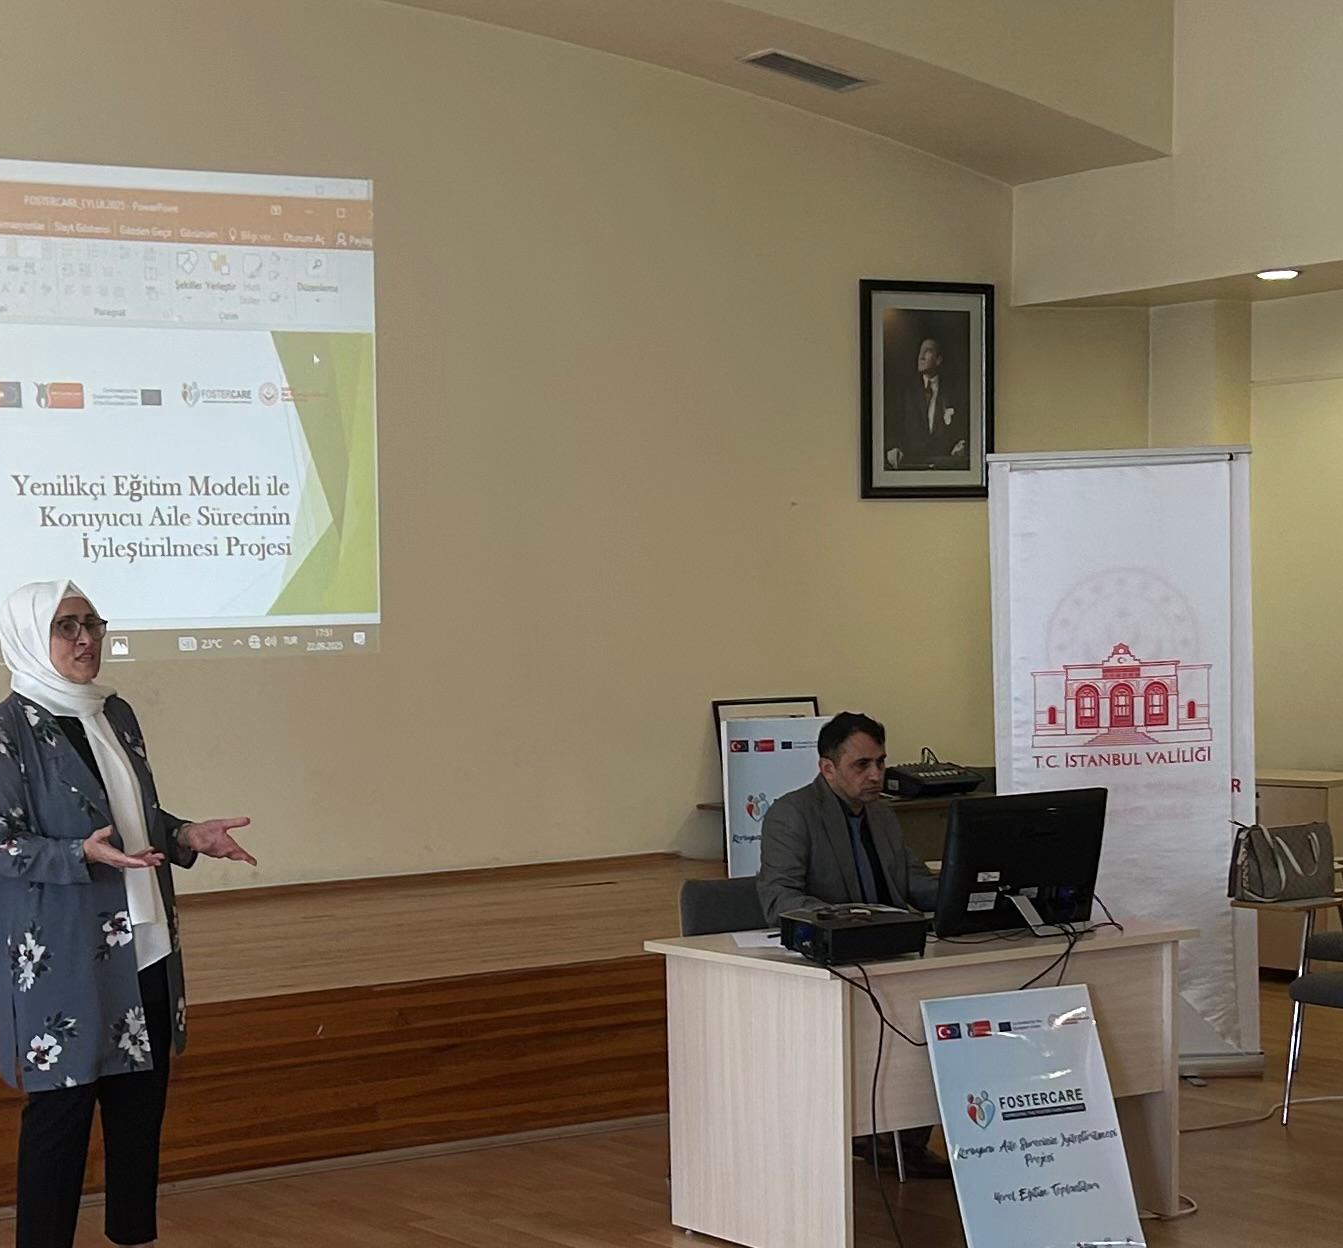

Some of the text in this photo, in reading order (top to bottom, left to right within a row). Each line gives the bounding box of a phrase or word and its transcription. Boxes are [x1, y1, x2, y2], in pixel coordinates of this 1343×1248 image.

[201, 388, 253, 400] FOSTERCARE
[11, 474, 291, 502] Yenilikçi Eğitim Modeli ile
[39, 505, 291, 532] Koruyucu Aile Sürecinin
[82, 532, 293, 564] İyileştirilmesi Projesi
[1065, 752, 1142, 768] İSTANBUL
[1146, 746, 1212, 764] VALİLİĞİ
[999, 1088, 1084, 1109] FOSTERCARE
